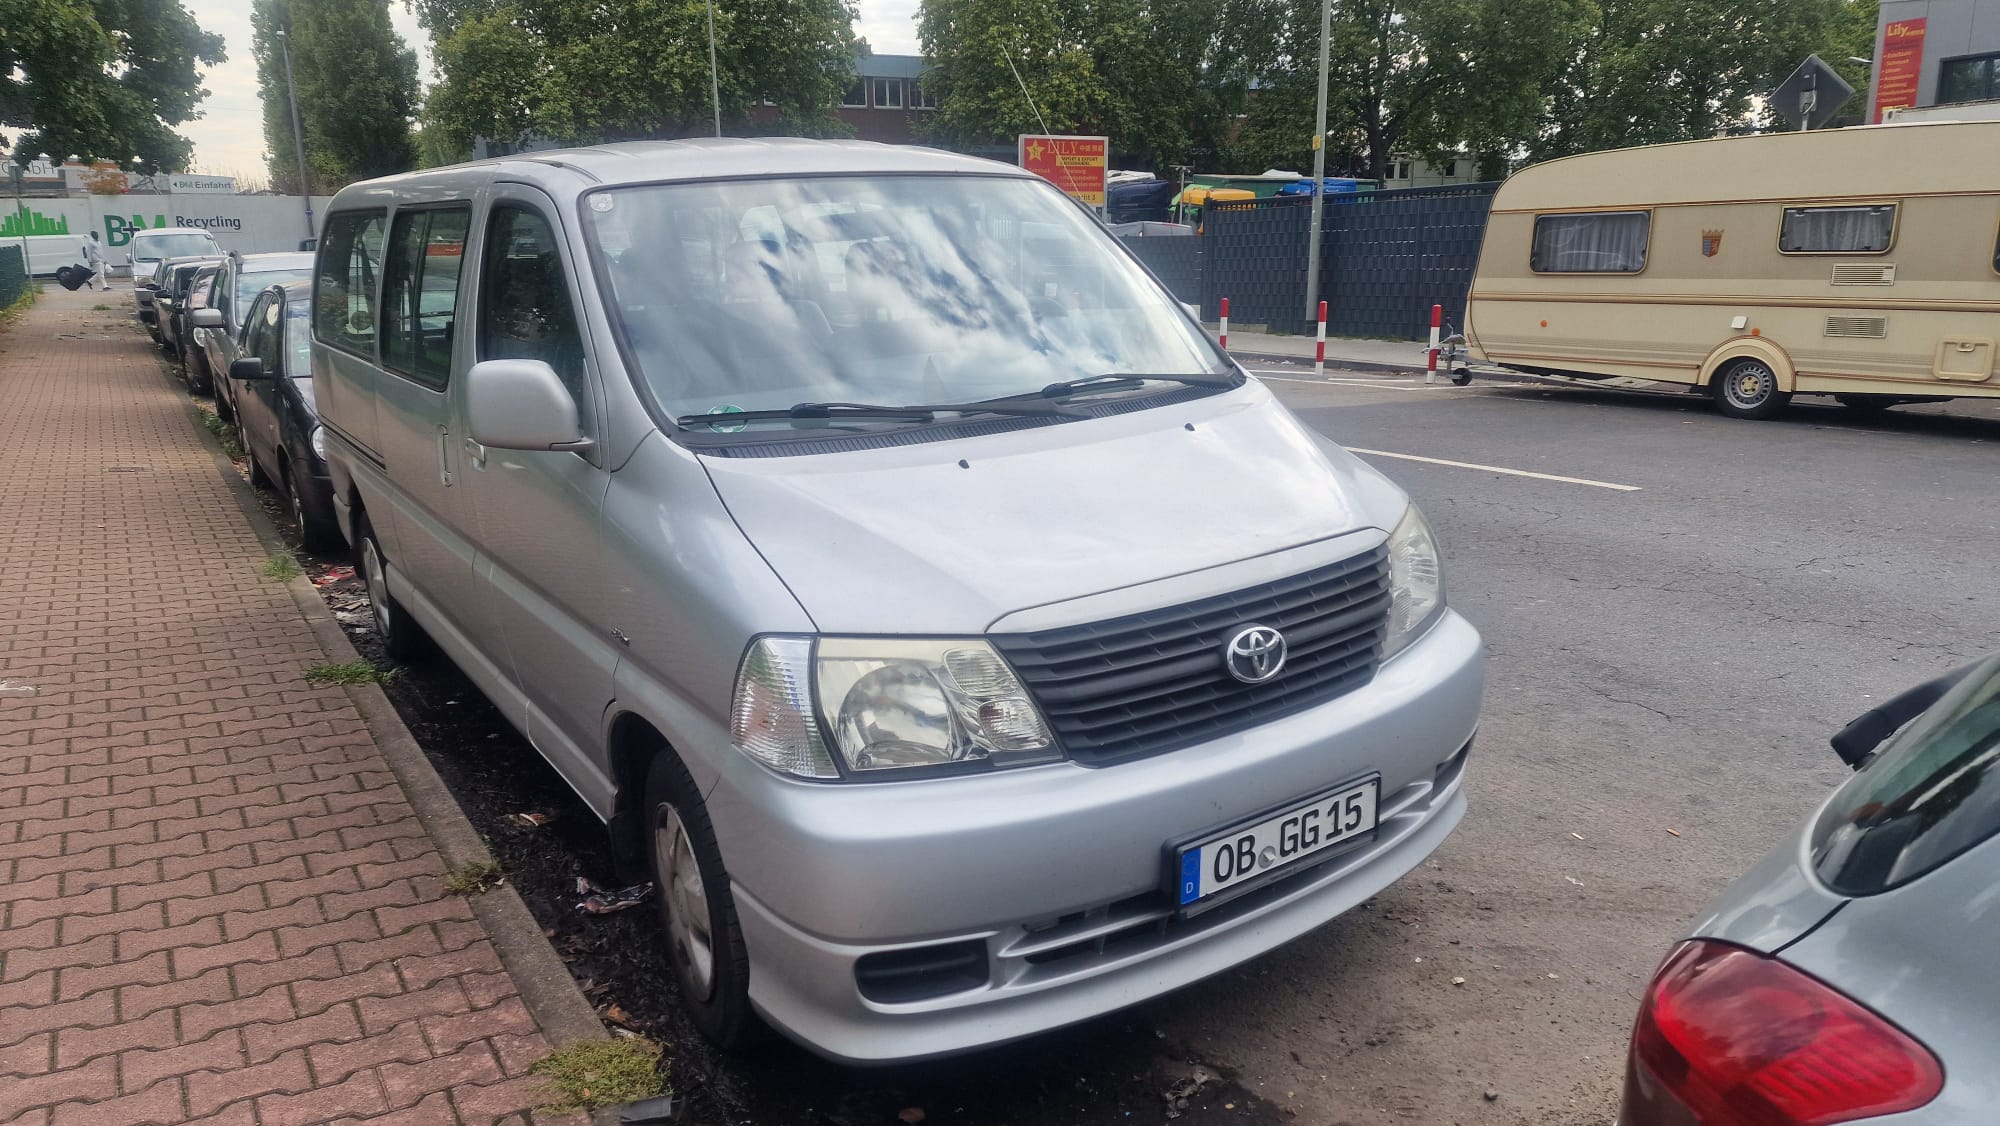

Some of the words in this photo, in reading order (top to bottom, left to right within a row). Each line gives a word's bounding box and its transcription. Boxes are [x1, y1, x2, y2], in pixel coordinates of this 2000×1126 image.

[1888, 23, 1908, 37] Lily
[1047, 141, 1079, 154] LILY
[195, 181, 232, 189] Einfahrt
[176, 215, 241, 230] Recycling
[1214, 834, 1257, 883] OB
[1279, 809, 1320, 857] GG
[1325, 792, 1363, 841] 15
[1186, 882, 1194, 894] D
